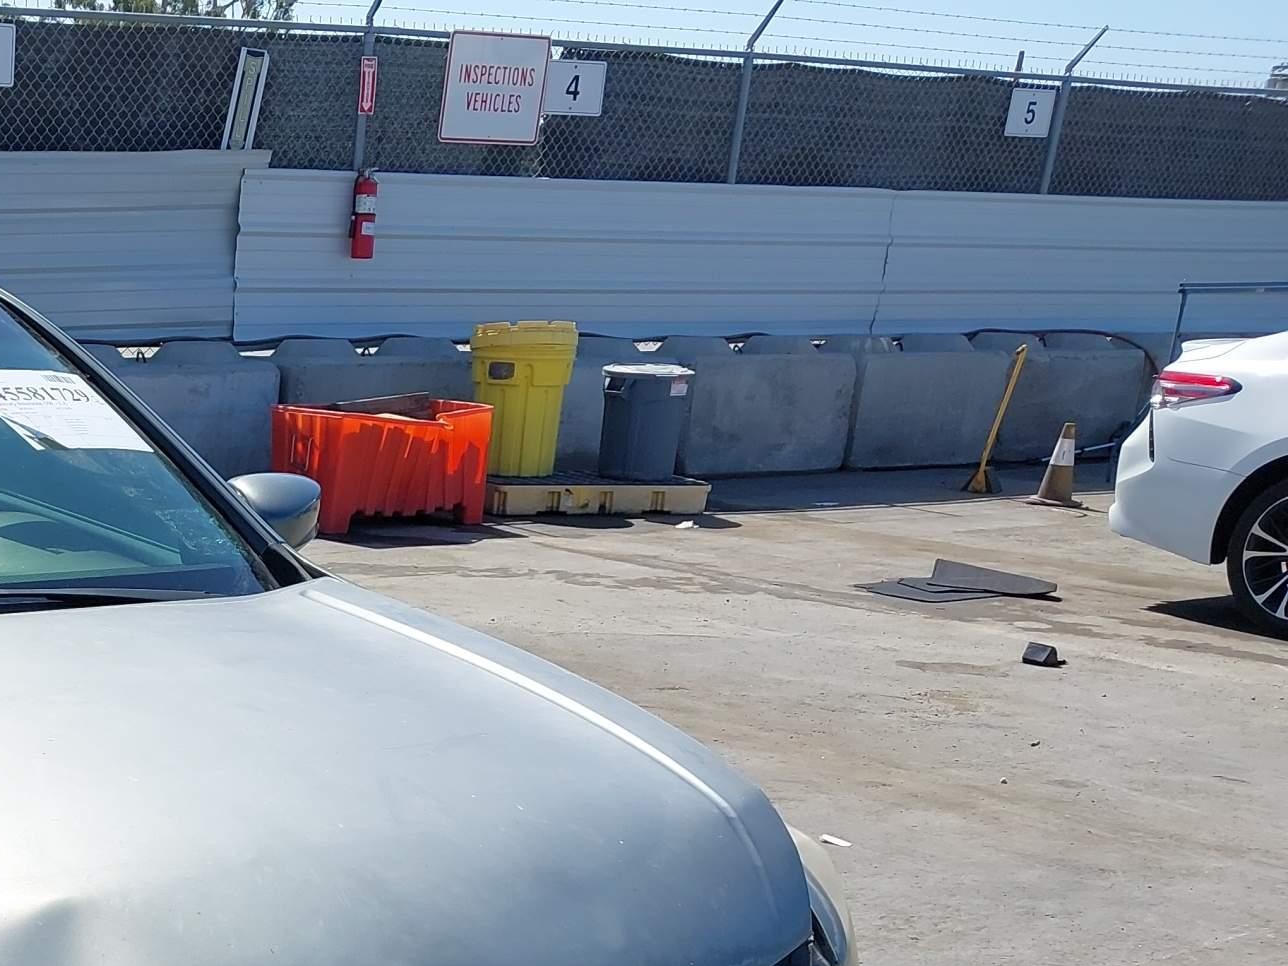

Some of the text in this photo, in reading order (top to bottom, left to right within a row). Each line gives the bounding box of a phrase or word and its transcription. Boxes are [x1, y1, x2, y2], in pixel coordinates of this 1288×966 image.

[457, 63, 536, 87] INSPECTIONS
[565, 74, 580, 102] 4
[466, 91, 522, 113] VEHICLES
[1024, 101, 1038, 125] 5
